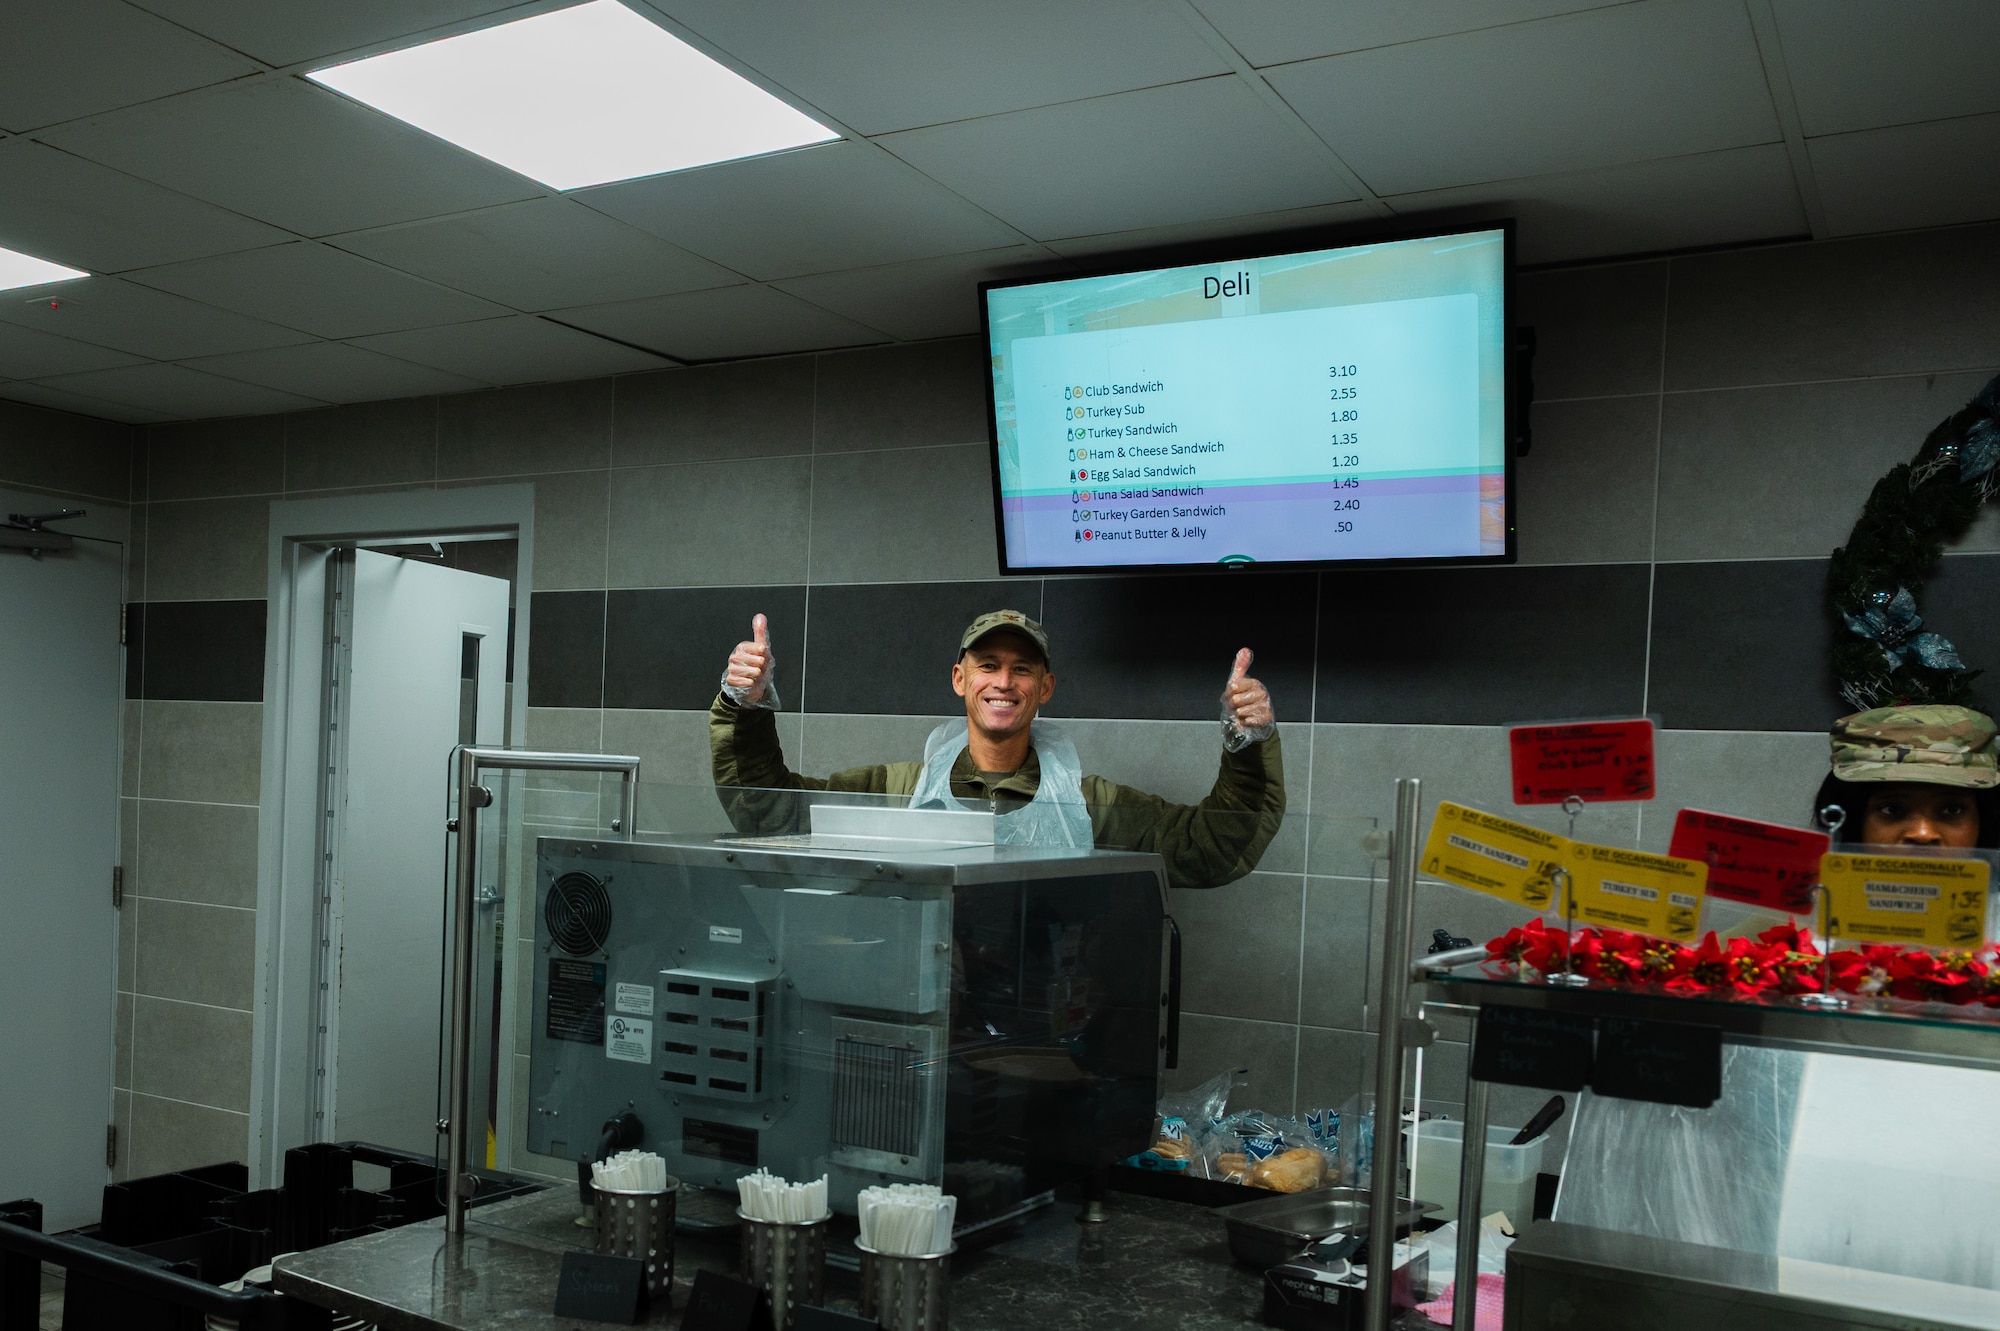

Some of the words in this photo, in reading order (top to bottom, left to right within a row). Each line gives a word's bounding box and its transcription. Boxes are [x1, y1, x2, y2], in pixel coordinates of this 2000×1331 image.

[1204, 271, 1250, 299] Deli
[1329, 364, 1357, 377] 3.10
[1085, 385, 1110, 397] Club
[1112, 380, 1164, 395] Sandwich
[1330, 387, 1357, 400] 2.55
[1086, 406, 1122, 418] Turkey
[1124, 404, 1145, 415] Sub
[1331, 410, 1358, 422] 1.80
[1088, 427, 1123, 439] Turkey
[1125, 422, 1178, 436] Sandwich
[1331, 433, 1358, 445] 1.35
[1089, 449, 1115, 459] Ham
[1117, 447, 1126, 458] &
[1128, 445, 1168, 457] Cheese
[1171, 441, 1225, 455] Sandwich
[1332, 455, 1359, 467] 1.20
[1091, 470, 1110, 481] Egg
[1112, 467, 1141, 479] Salad
[1143, 464, 1196, 477] Sandwich
[1333, 477, 1359, 489] 1.45
[1092, 490, 1117, 500] Tuna
[1120, 487, 1149, 499] Salad
[1152, 485, 1204, 498] Sandwich
[1334, 499, 1360, 511] 2.40
[1093, 510, 1128, 522] Turkey
[1130, 507, 1170, 519] Garden
[1172, 505, 1226, 517] Sandwich
[1094, 530, 1132, 541] Peanut
[1134, 529, 1168, 540] Butter
[1171, 527, 1180, 538] &
[1182, 526, 1207, 540] Jelly
[1334, 521, 1353, 532] .50
[1462, 810, 1480, 820] EAT
[1482, 815, 1553, 842] OCCASIONALLY
[1450, 834, 1484, 853] TURKEY
[1484, 845, 1530, 867] SANDWICH
[1592, 848, 1610, 857] EAT
[1612, 851, 1689, 870] OCCASIONALLY
[1851, 858, 1872, 867] EAT
[1875, 859, 1965, 872] OCCASIONALLY
[1602, 881, 1637, 895] TURKEY
[1868, 899, 1925, 910] SANDWICH
[571, 1269, 620, 1296] Spoons
[1282, 1278, 1321, 1293] nephron
[1297, 1289, 1323, 1302] nitrile
